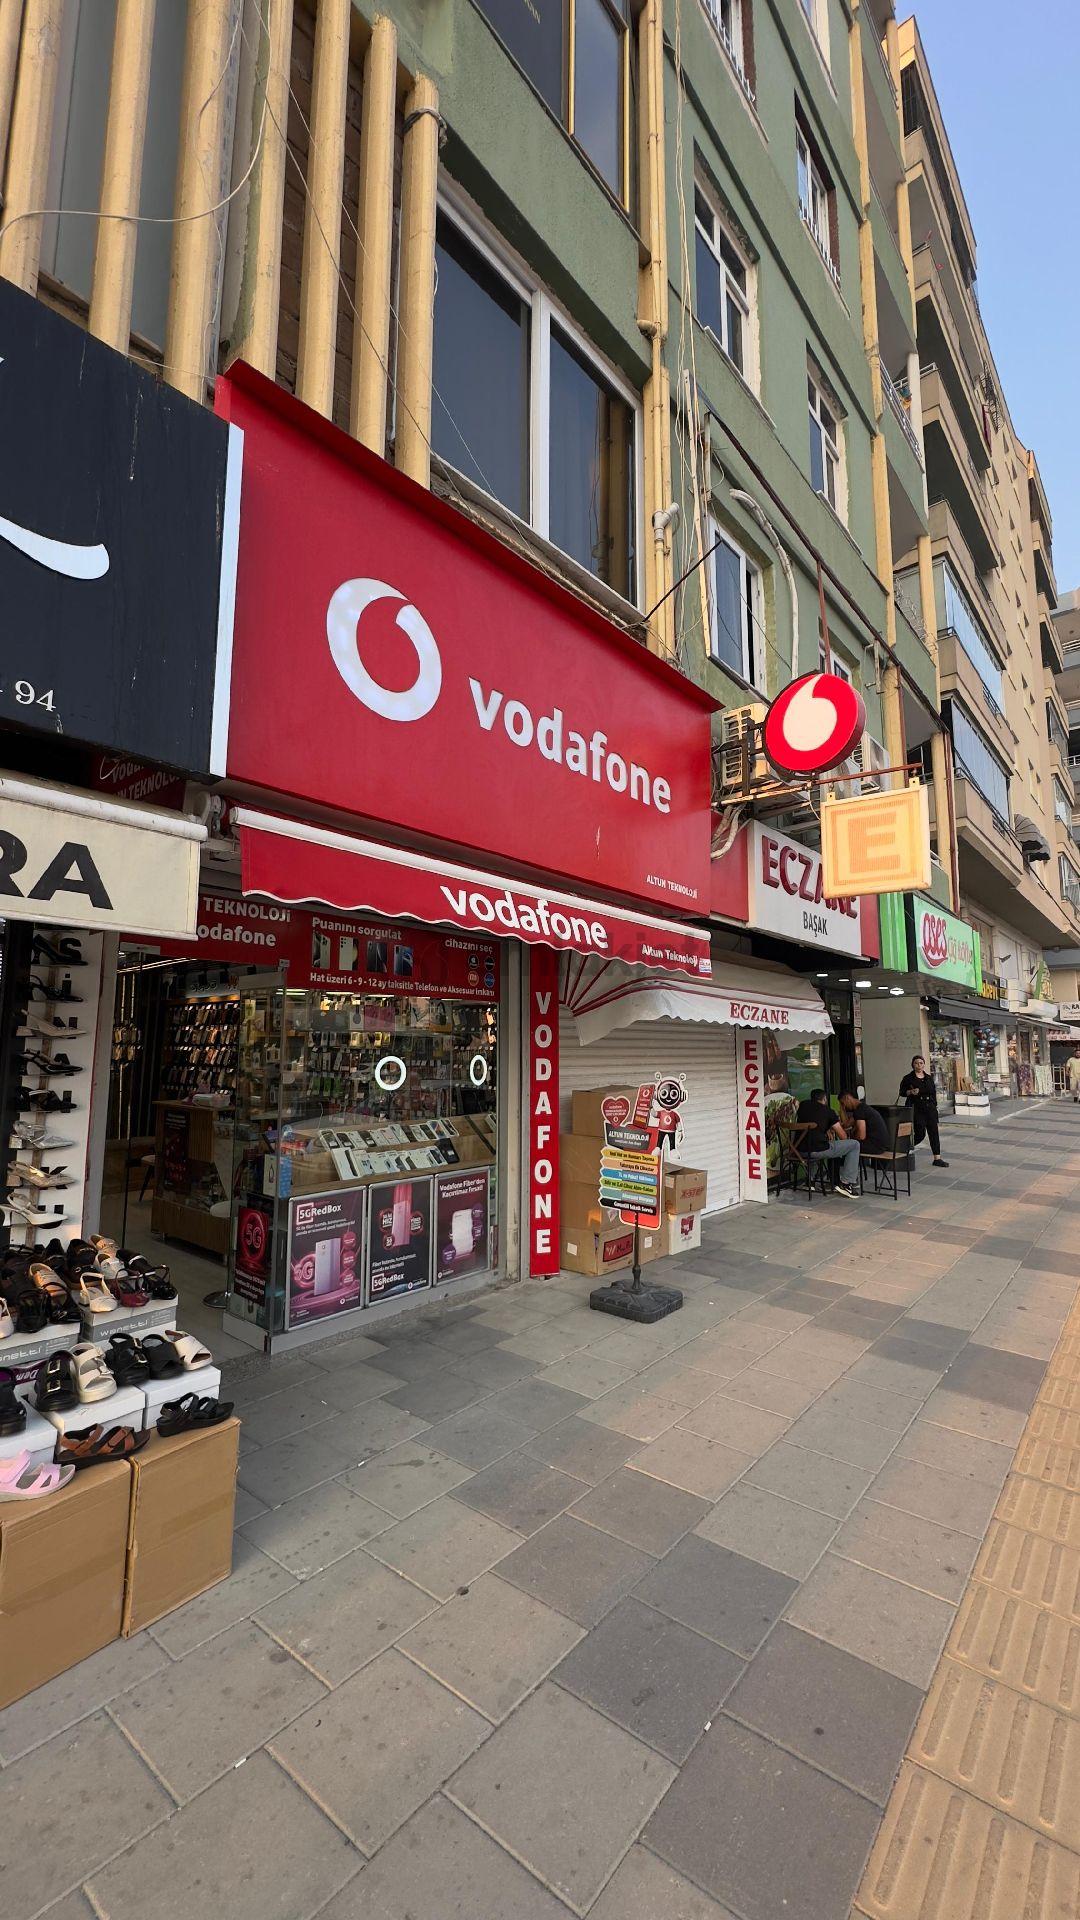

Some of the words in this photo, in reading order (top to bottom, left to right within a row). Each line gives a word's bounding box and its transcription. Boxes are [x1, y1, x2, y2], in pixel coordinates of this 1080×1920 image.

[15, 680, 56, 712] 94
[468, 676, 671, 814] vodafone
[847, 811, 901, 873] E
[312, 916, 356, 933] Puanını
[358, 926, 402, 941] sorgulat
[439, 886, 609, 949] vodafone
[802, 911, 828, 938] BAŞAK
[197, 923, 277, 947] odafone
[444, 938, 478, 952] cihazını
[479, 944, 494, 955] seç
[310, 972, 325, 982] Hat
[326, 974, 347, 985] üzeri
[347, 976, 353, 985] 6
[357, 977, 363, 986] 9
[368, 978, 377, 987] 12
[377, 981, 387, 990] ay
[388, 980, 414, 990] taksitle
[415, 982, 438, 992] Telefon
[447, 986, 475, 994] Aksesuar
[730, 1001, 789, 1025] ECZANE
[534, 992, 553, 1254] VODAFONE
[743, 1039, 762, 1180] ECZANE
